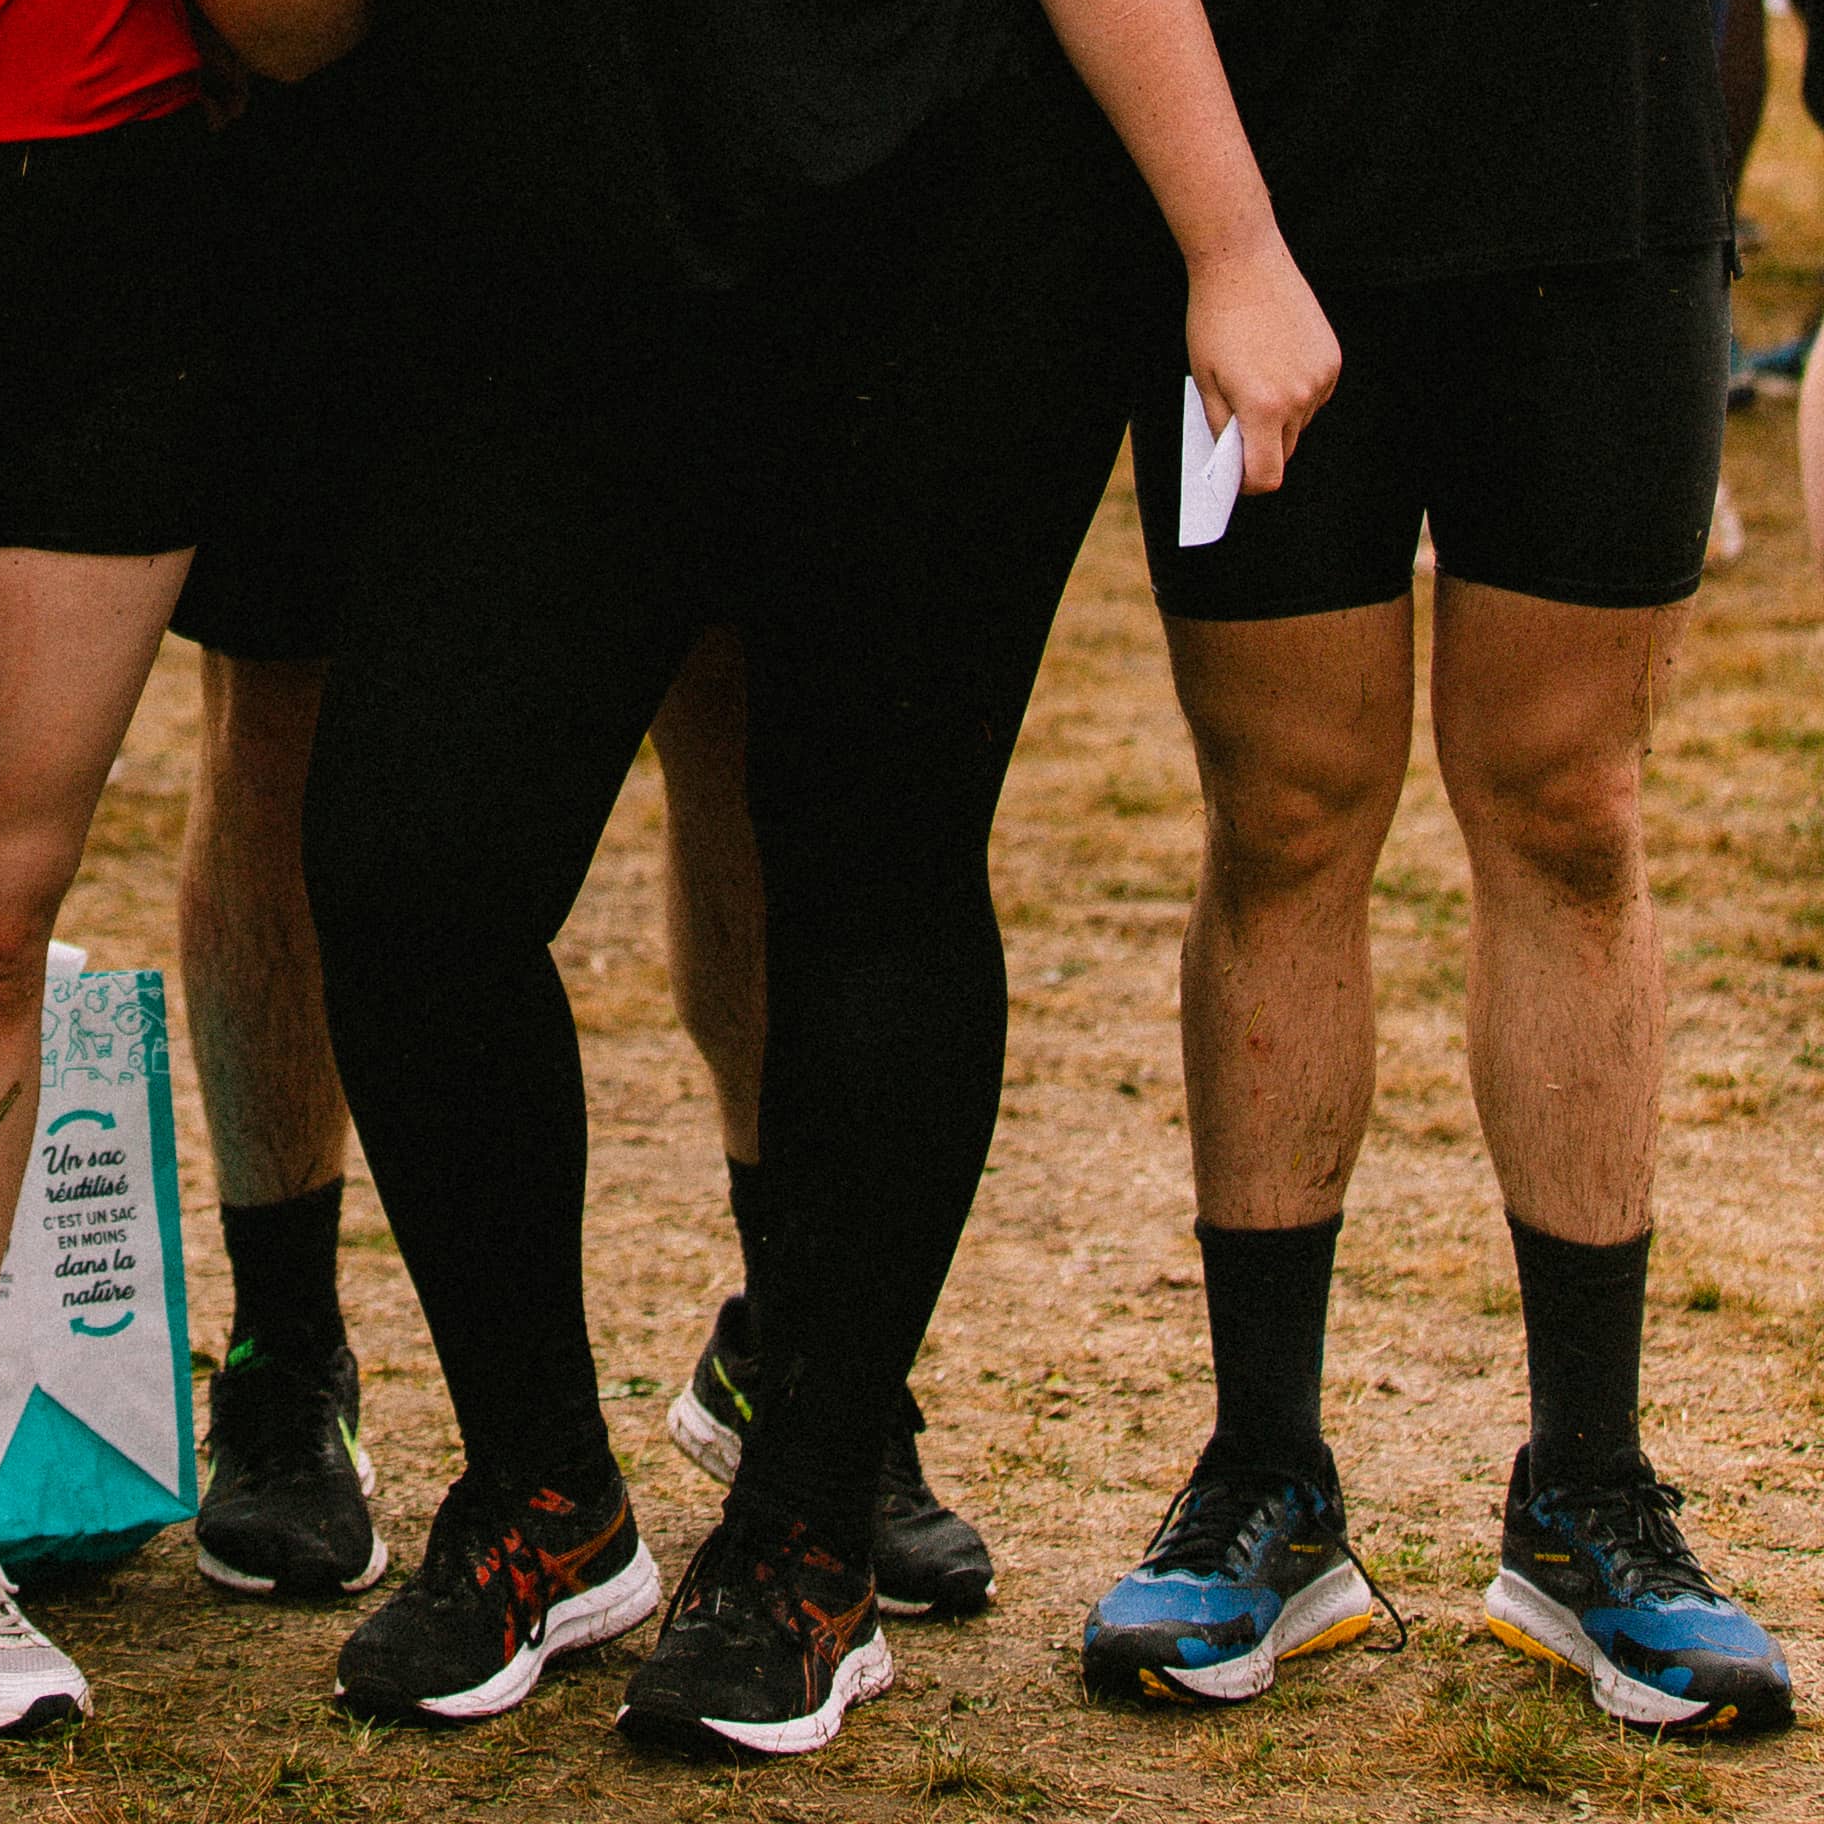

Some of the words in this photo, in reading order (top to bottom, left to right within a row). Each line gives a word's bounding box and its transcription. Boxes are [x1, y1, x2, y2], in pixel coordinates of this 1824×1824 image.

[42, 1144, 81, 1176] Un
[87, 1149, 126, 1167] sac
[45, 1174, 129, 1203] réutilisé
[43, 1213, 81, 1230] C'EST
[86, 1210, 108, 1227] UN
[110, 1206, 137, 1223] SAC
[58, 1235, 76, 1250] EN
[81, 1228, 126, 1248] MOINS
[55, 1254, 108, 1278] dans
[113, 1249, 136, 1271] la
[62, 1279, 135, 1308] nature
